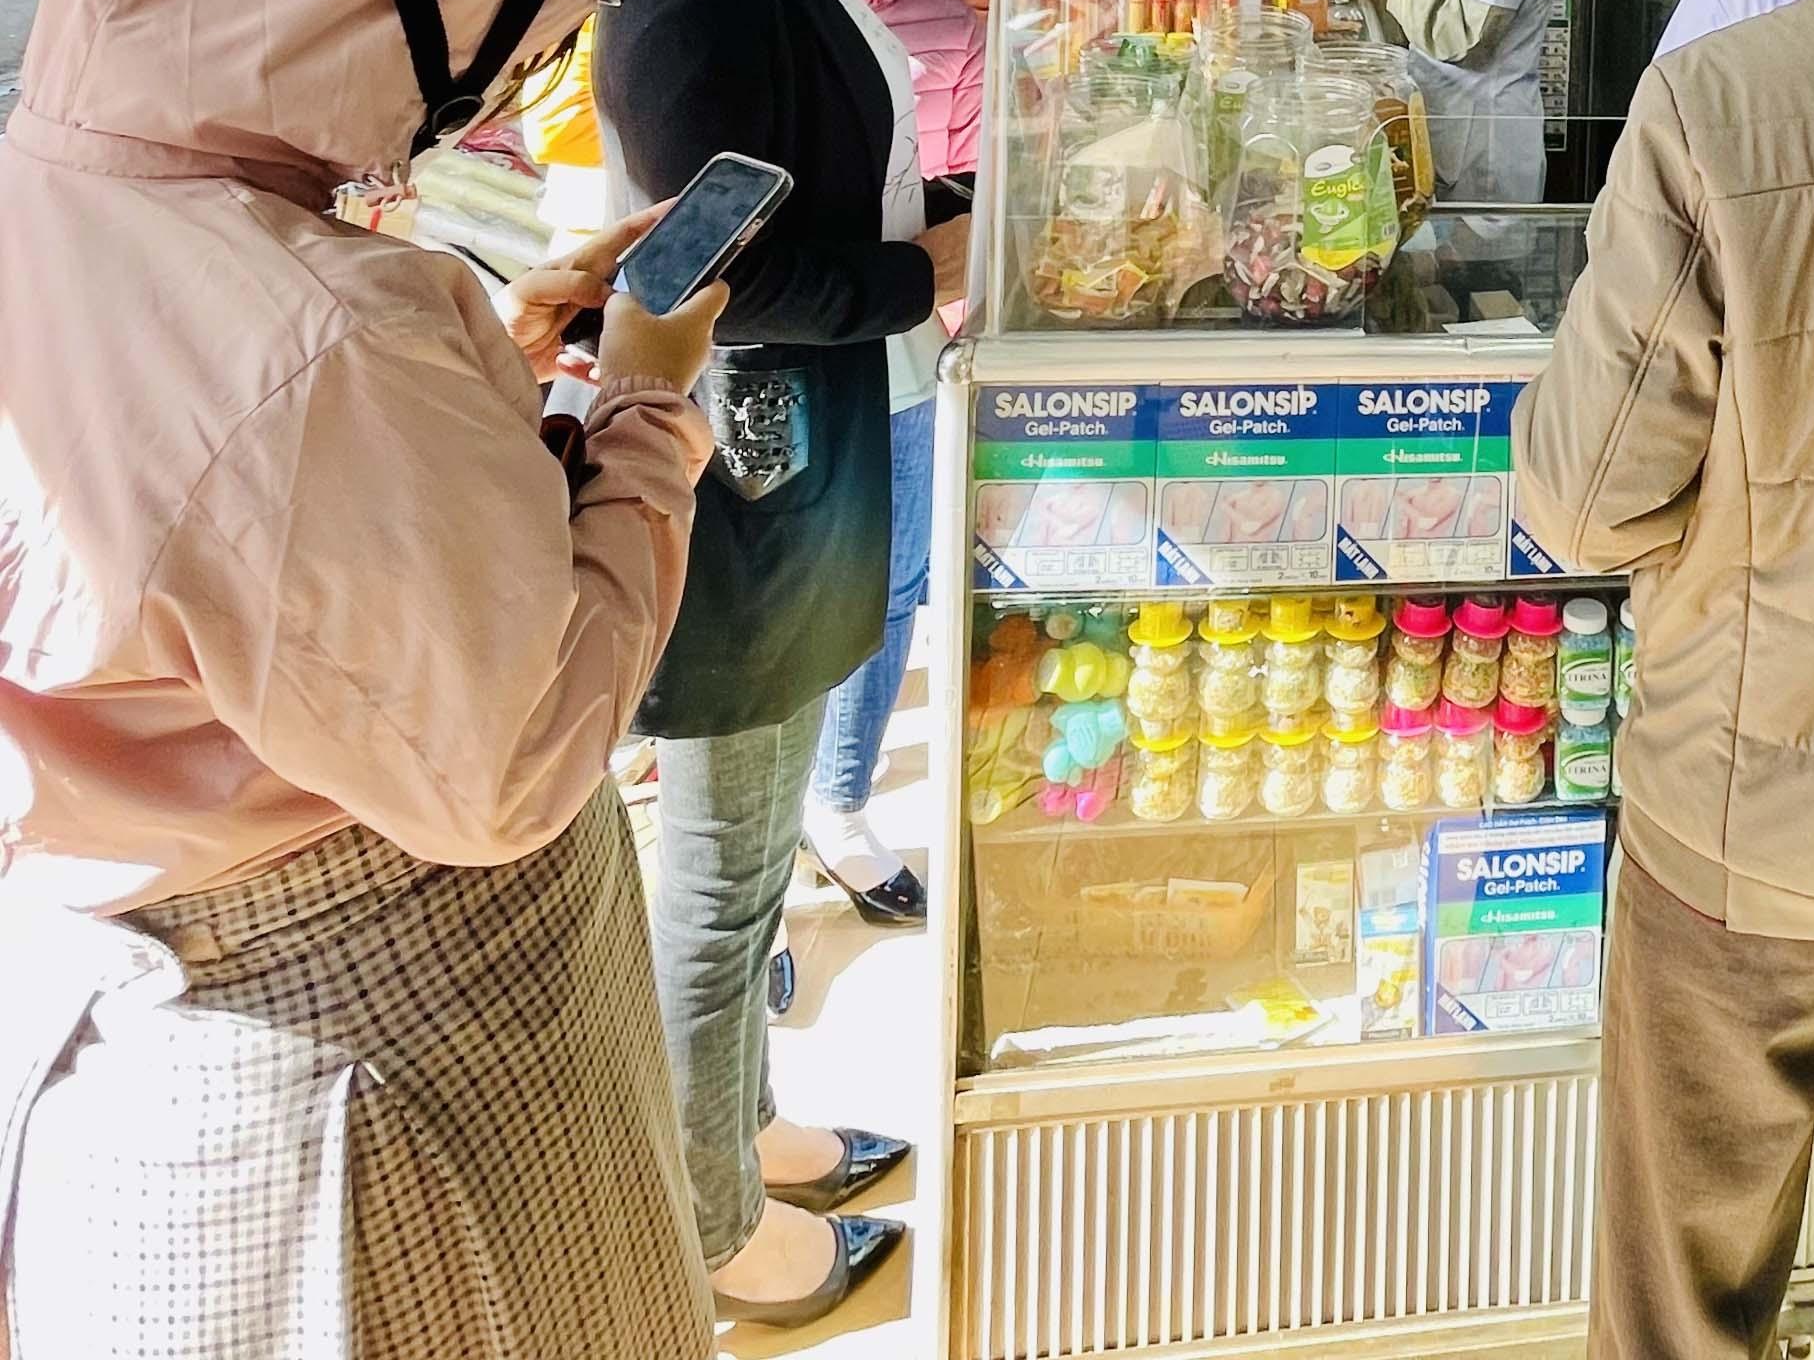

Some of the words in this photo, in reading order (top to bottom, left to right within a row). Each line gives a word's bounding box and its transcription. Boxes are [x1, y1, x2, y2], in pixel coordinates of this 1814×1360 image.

[995, 391, 1136, 418] SALONSIP
[1179, 390, 1316, 417] SALONSIP
[1357, 388, 1490, 415] SALONSIP
[1024, 420, 1106, 437] Gel-Patch
[1209, 418, 1289, 435] Gel-Patch
[1386, 417, 1463, 433] Gel-Patch
[1456, 850, 1584, 881] SALONSIP
[1484, 878, 1558, 896] Gel-Patch
